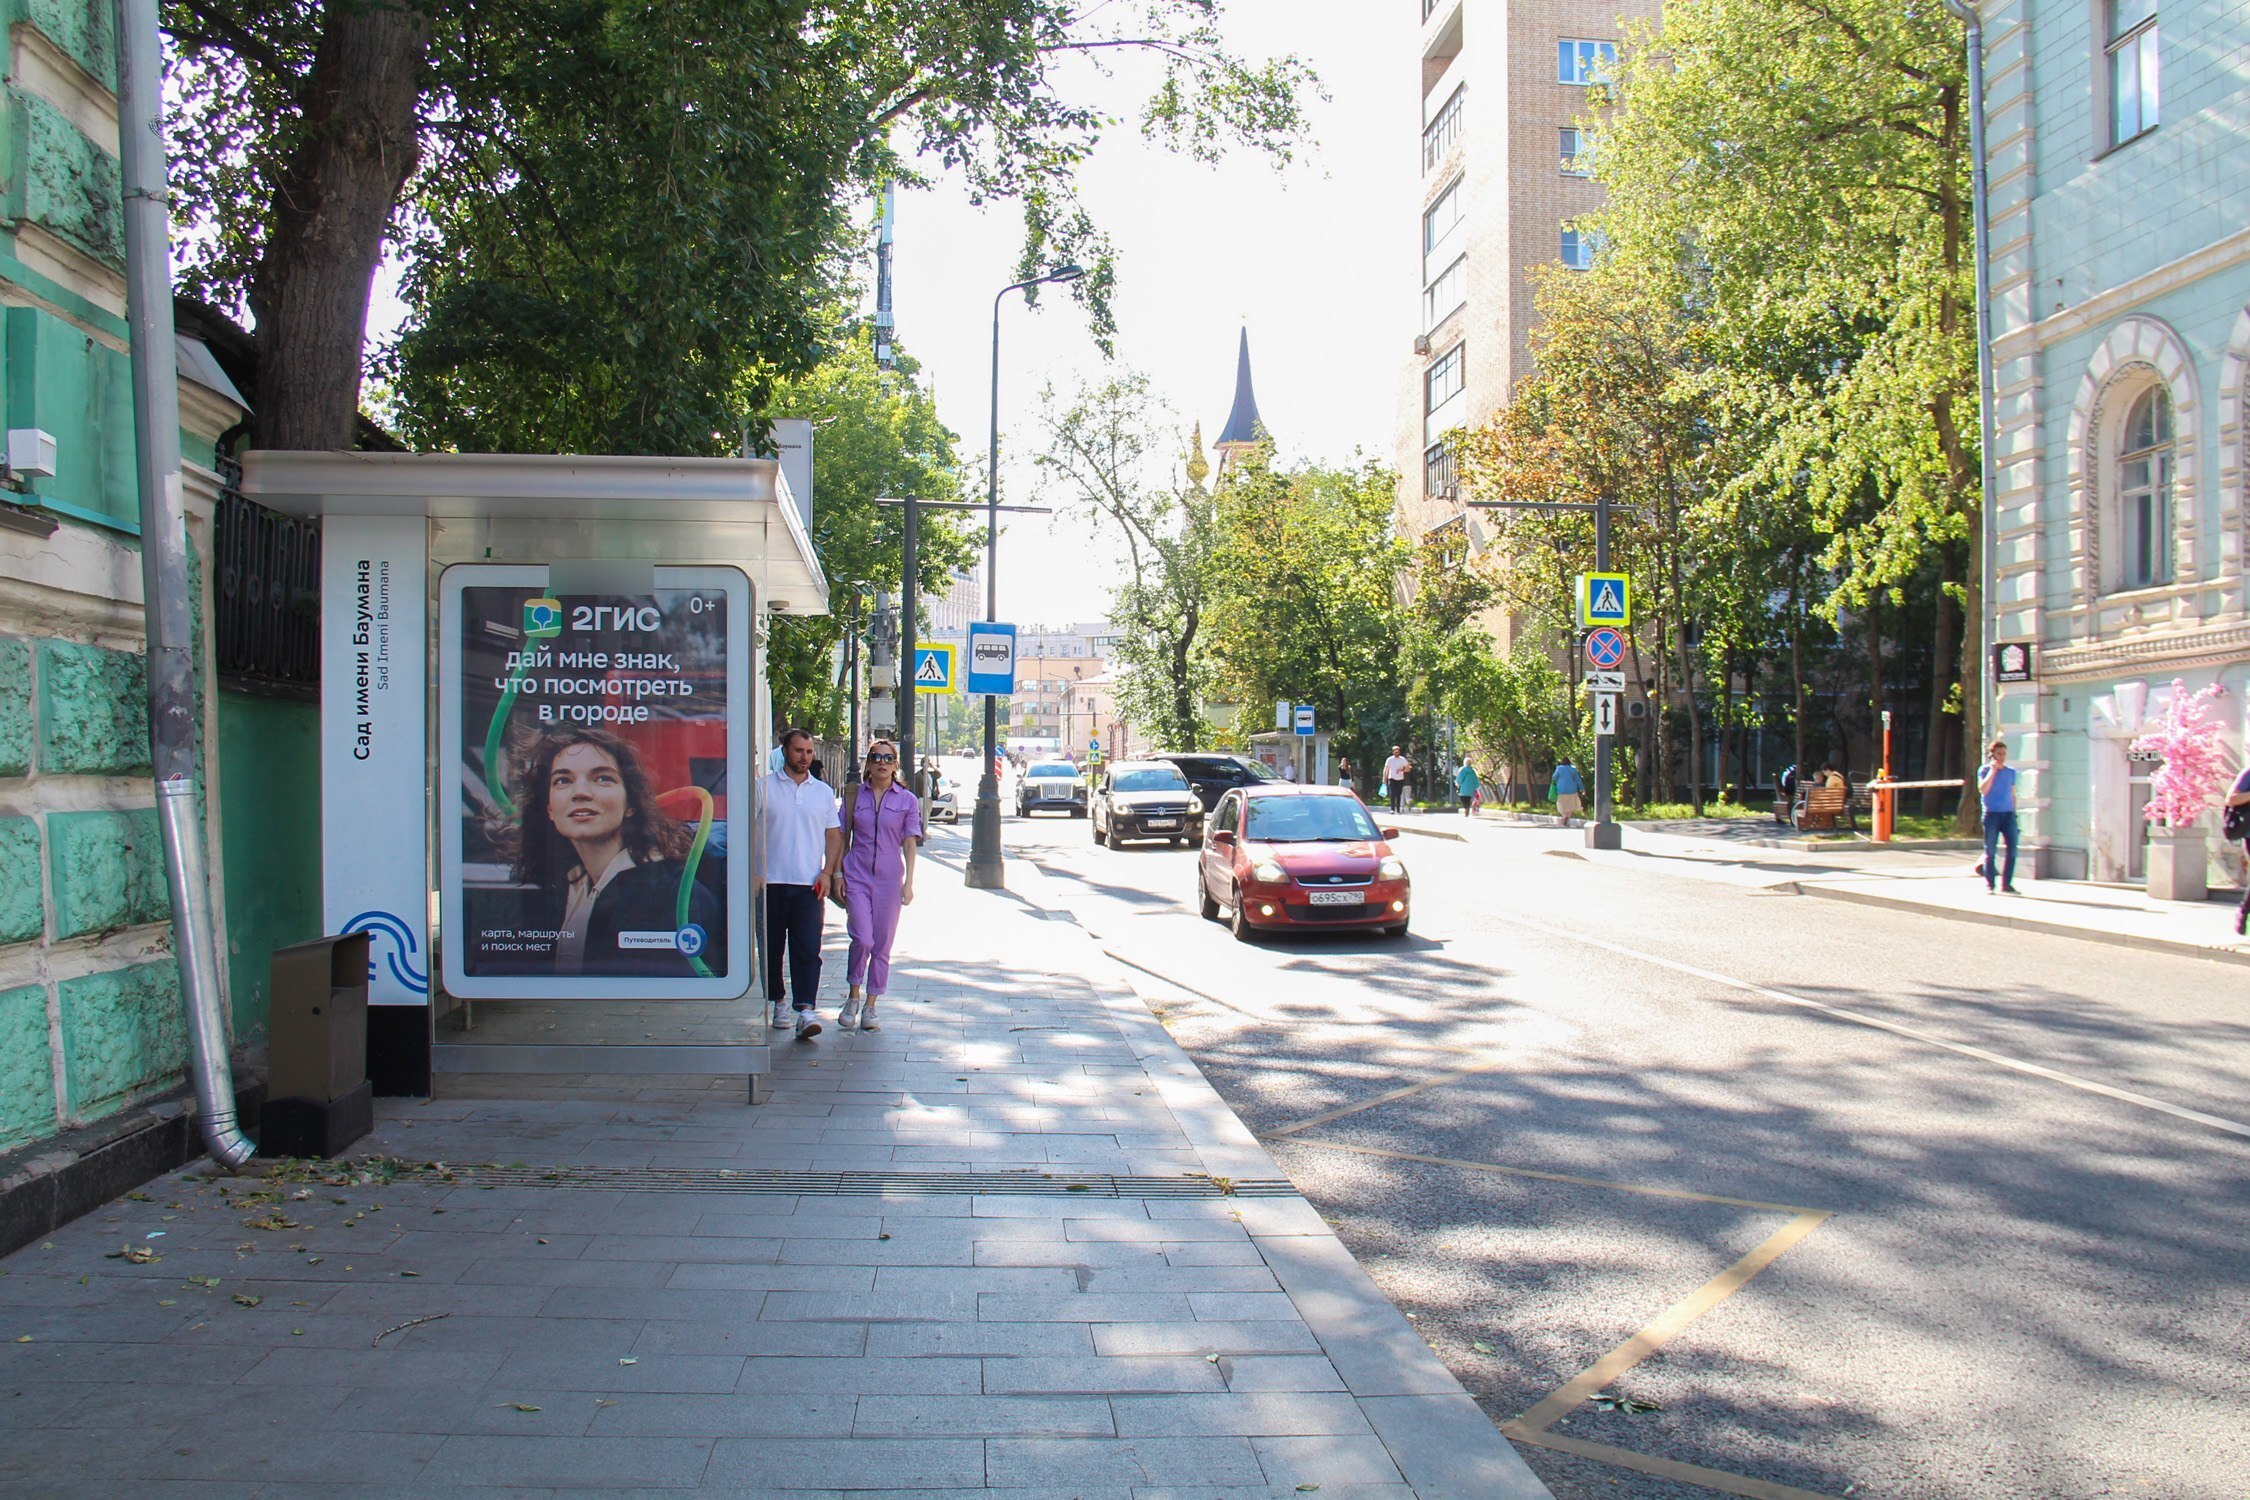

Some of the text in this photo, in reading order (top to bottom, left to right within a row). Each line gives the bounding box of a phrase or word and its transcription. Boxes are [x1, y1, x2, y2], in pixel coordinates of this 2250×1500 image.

[690, 597, 715, 614] 0+
[377, 560, 391, 690] Sad Imeni Baumana
[572, 606, 661, 632] 2ГИС
[353, 559, 374, 760] Сад имени Баумана
[505, 645, 680, 673] дай мне знак,
[494, 677, 693, 700] что посмотреть
[538, 704, 649, 726] в городе
[481, 929, 575, 940] карта, маршруты
[623, 936, 672, 945] Путеводитель
[481, 943, 552, 952] и поиск мест
